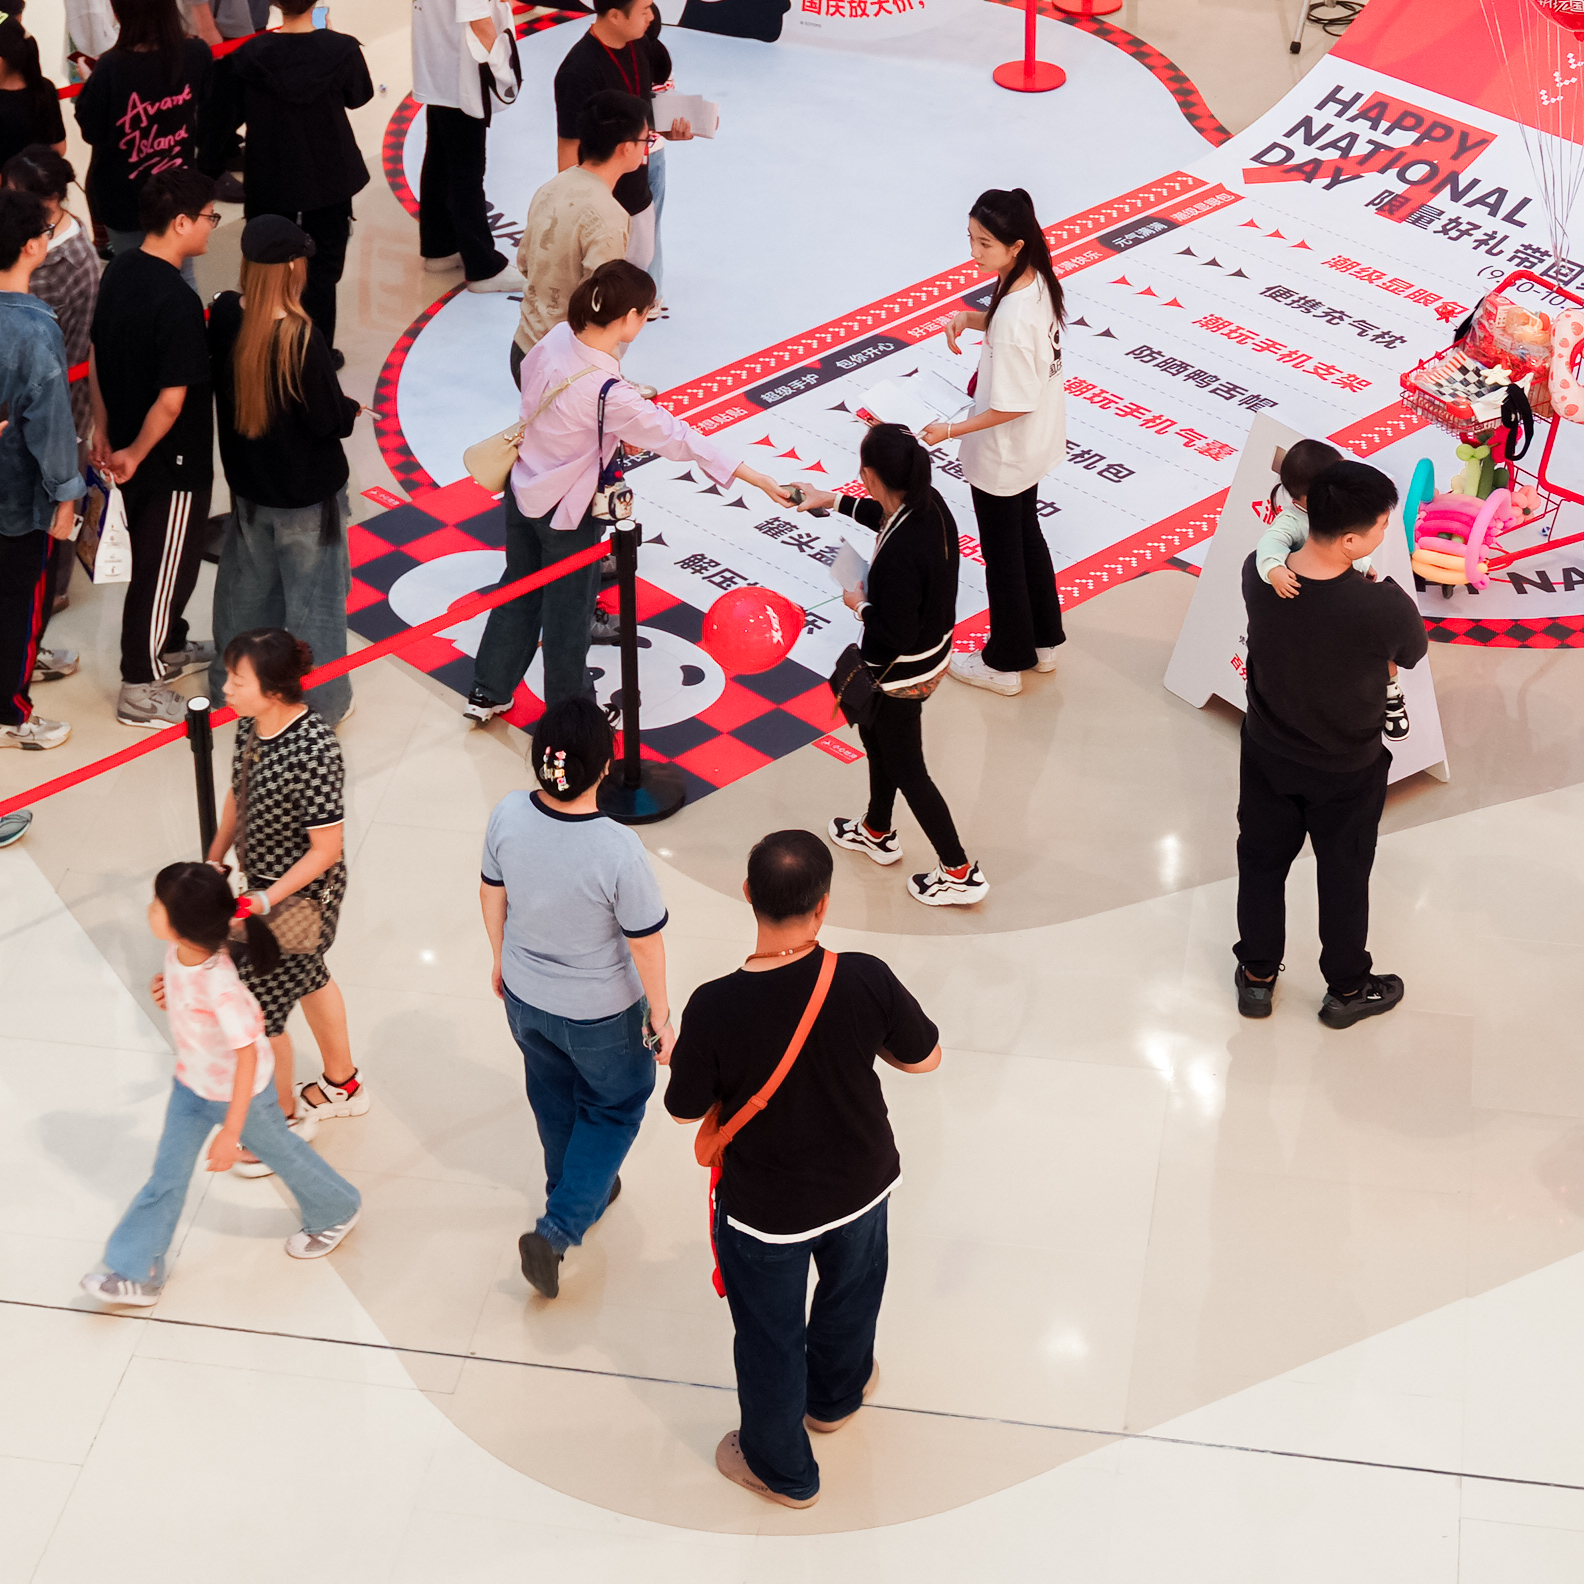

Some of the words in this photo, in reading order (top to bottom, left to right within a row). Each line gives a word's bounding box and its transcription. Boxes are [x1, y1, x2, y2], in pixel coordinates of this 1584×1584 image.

[117, 83, 193, 134] Avant
[1314, 84, 1490, 161] HAPPY
[118, 124, 189, 164] Island
[1249, 141, 1365, 192] DAY
[1282, 115, 1533, 228] NATIONAL
[1112, 221, 1169, 249] 元气满满
[1258, 284, 1407, 351] 便携充气枕
[836, 341, 895, 370] 包你开心
[1124, 344, 1279, 414] 防晒鸭舌帽
[1191, 312, 1373, 394] 潮玩手机支架
[1063, 376, 1239, 462] 潮玩手机气囊
